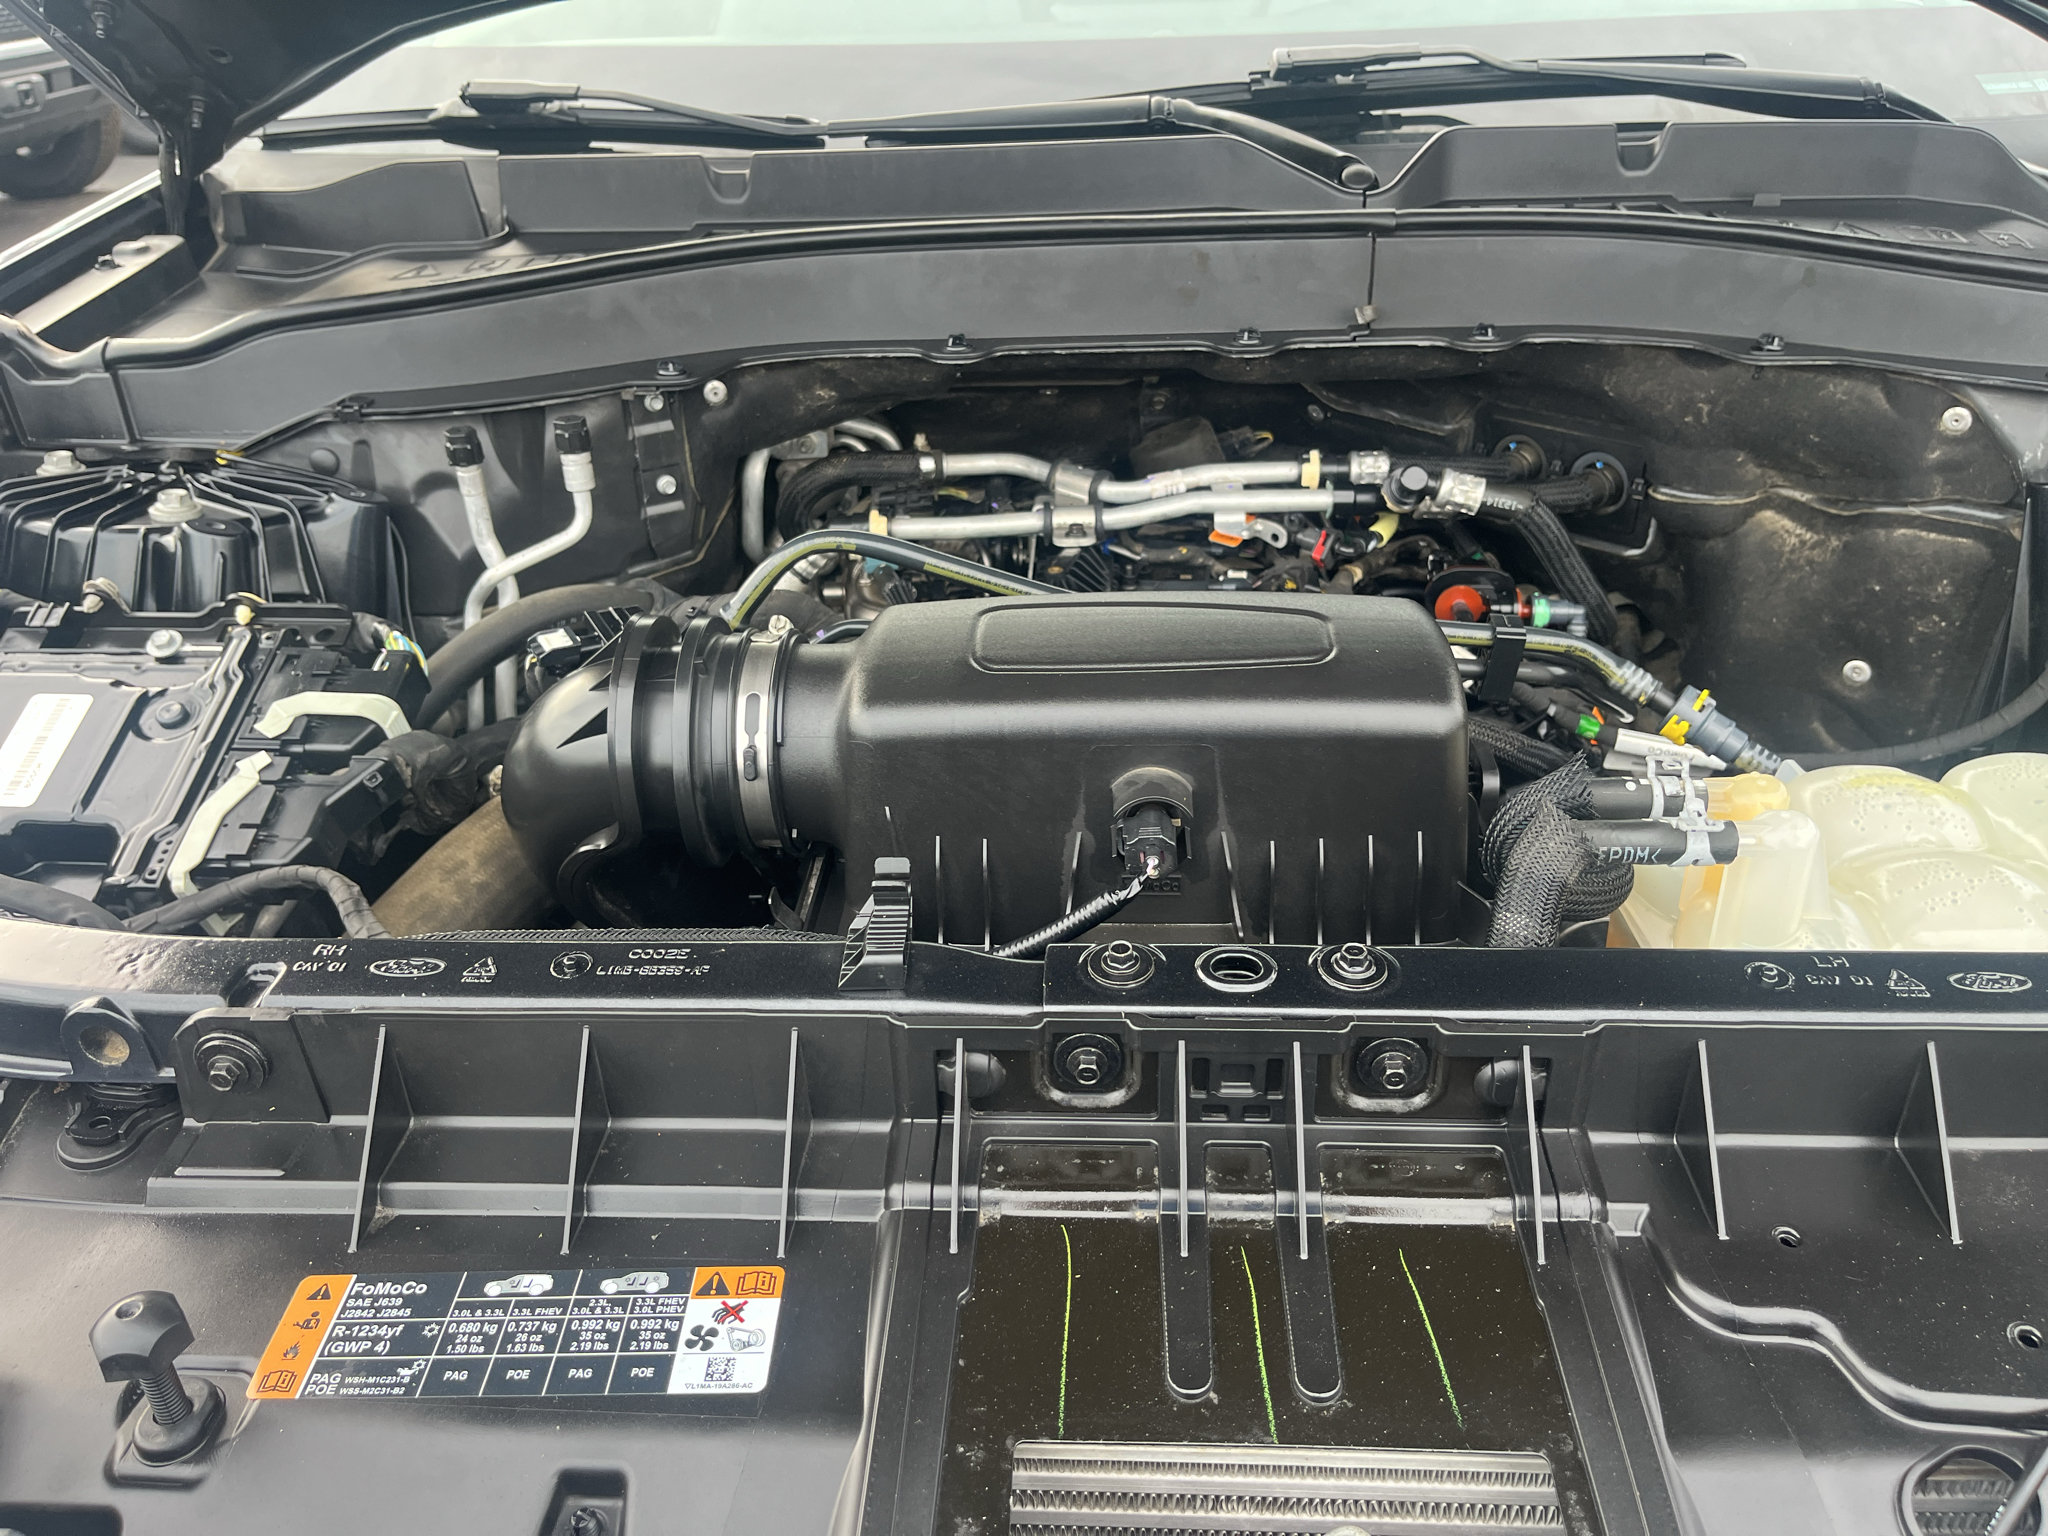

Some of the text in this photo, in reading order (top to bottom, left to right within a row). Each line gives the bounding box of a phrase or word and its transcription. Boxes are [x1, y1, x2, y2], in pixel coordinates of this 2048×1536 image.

[312, 944, 348, 956] RH
[1811, 955, 1850, 967] LH
[350, 1281, 428, 1296] FoMoCo
[346, 1297, 403, 1307] SAE J639
[636, 1297, 686, 1306] 3.3L FHEV
[340, 1308, 411, 1319] J2842 J2845
[452, 1308, 505, 1317] 3.0L & 3.3L
[512, 1307, 563, 1316] 3.3L FHEV
[572, 1306, 624, 1315] 3.0L & 3.3L
[633, 1305, 684, 1314] 3.0L PHEV
[448, 1322, 498, 1335] 0.680 kg
[507, 1321, 557, 1334] 0.737 kg
[570, 1319, 621, 1332] 0.992 kg
[629, 1318, 680, 1332] 0.992 kg
[332, 1324, 405, 1339] R-1234yf
[579, 1331, 606, 1340] 35 oz
[638, 1331, 666, 1340] 35 oz
[455, 1335, 470, 1343] 24
[514, 1333, 528, 1342] 26
[324, 1340, 391, 1356] (GWP 4)
[446, 1344, 485, 1354] 1.50 lbs
[506, 1343, 545, 1352] 1.63 lbs
[569, 1341, 609, 1351] 2.19 lbs
[629, 1340, 669, 1350] 2.19 lbs
[443, 1370, 468, 1381] PAG
[506, 1369, 531, 1380] POE
[568, 1368, 593, 1378] PAG
[630, 1367, 655, 1378] POE
[309, 1372, 342, 1384] PAG
[304, 1384, 339, 1395] POE
